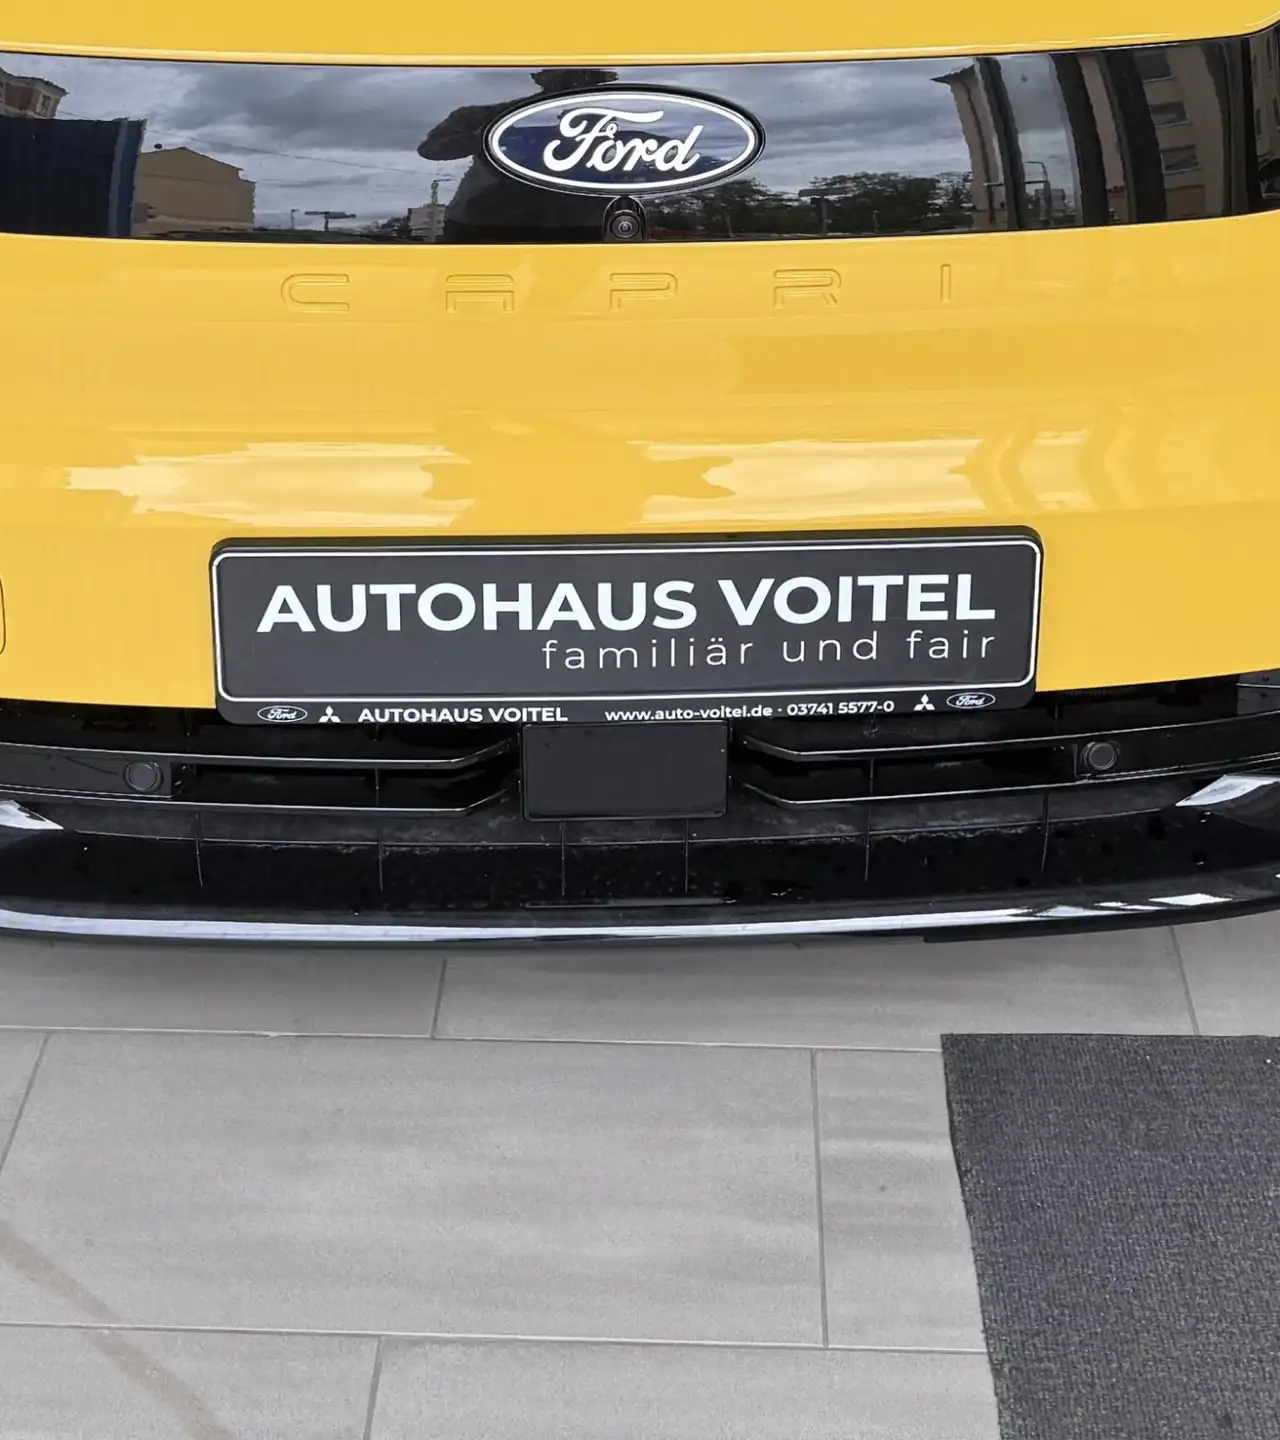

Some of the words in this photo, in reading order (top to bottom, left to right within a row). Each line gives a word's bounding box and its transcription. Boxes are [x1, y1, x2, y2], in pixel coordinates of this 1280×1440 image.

[543, 107, 703, 172] Ford
[281, 263, 951, 313] CAPRI
[256, 581, 698, 633] AUTOHAUS
[718, 573, 996, 626] VOITEL
[542, 636, 754, 670] familiär
[782, 631, 878, 663] und
[906, 629, 996, 659] fair
[267, 706, 298, 721] Ford
[358, 708, 484, 723] AUTOHAUS
[488, 707, 568, 722] VOITEL
[605, 704, 773, 721] www.auto-voitel.de
[787, 702, 834, 716] 03741
[838, 700, 895, 714] 5577-0
[955, 693, 986, 708] Ford
